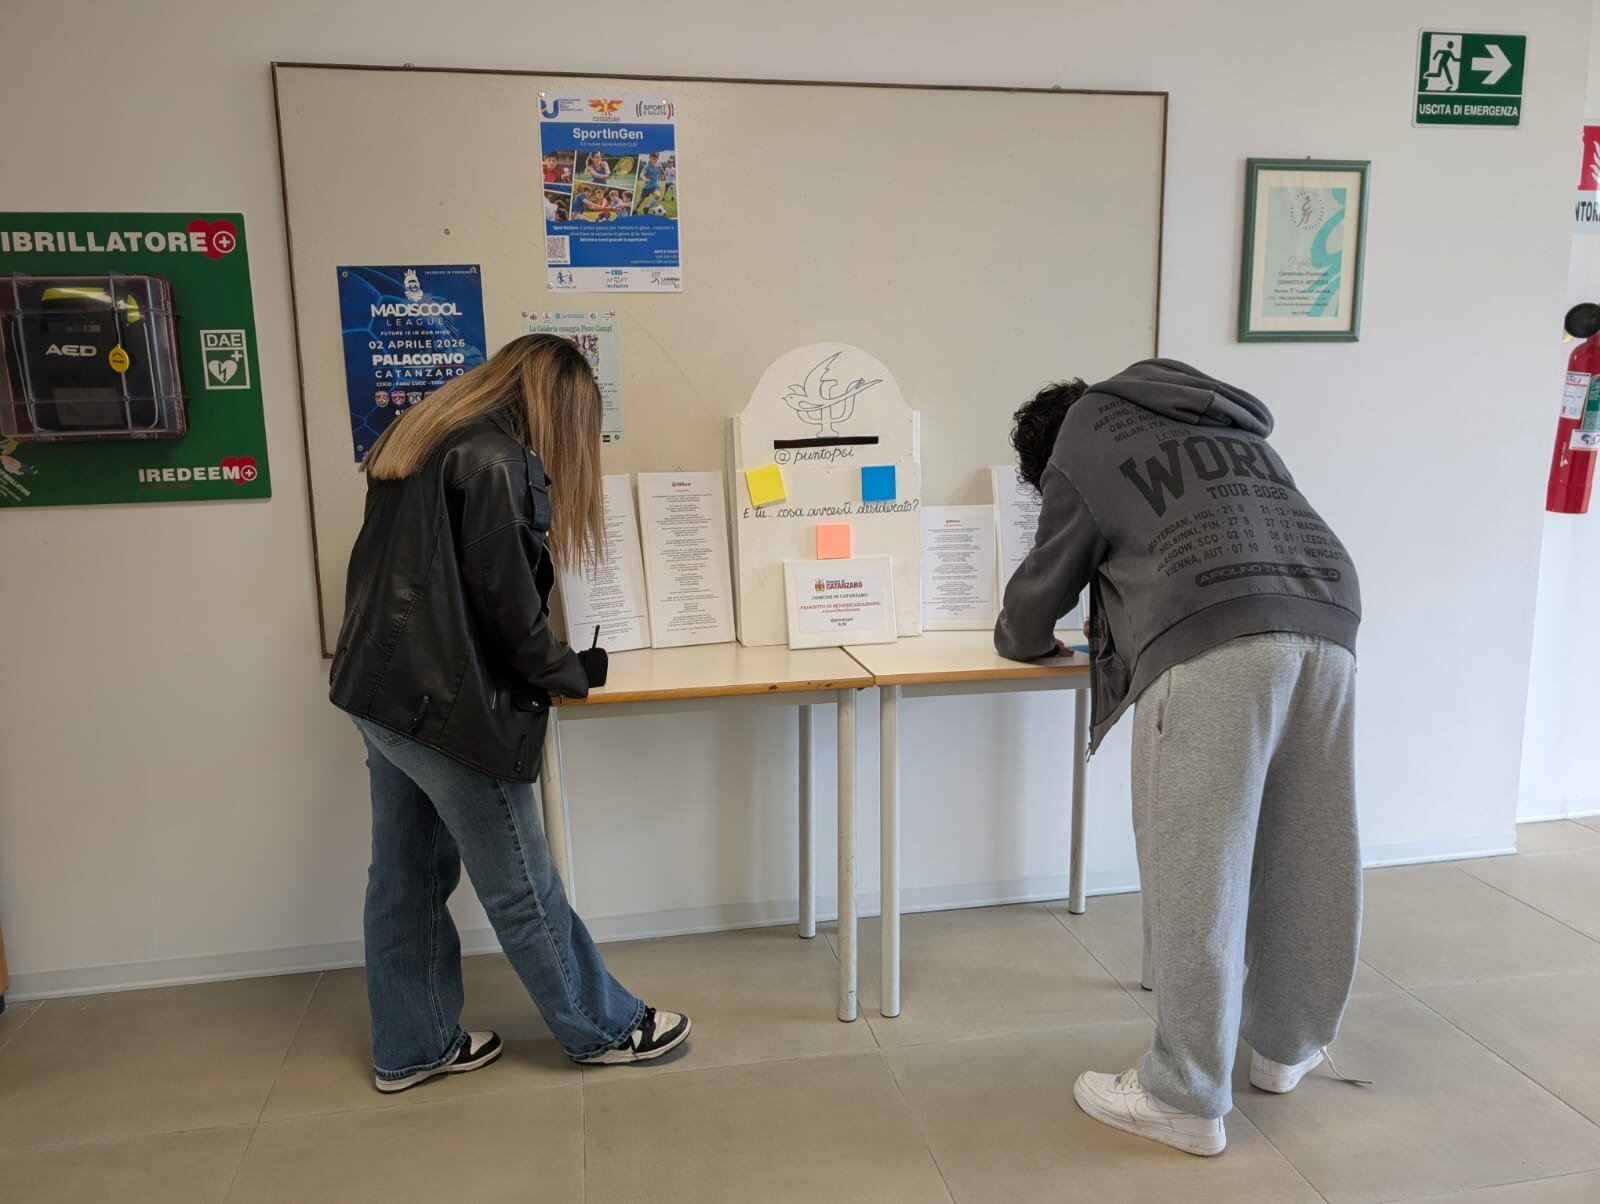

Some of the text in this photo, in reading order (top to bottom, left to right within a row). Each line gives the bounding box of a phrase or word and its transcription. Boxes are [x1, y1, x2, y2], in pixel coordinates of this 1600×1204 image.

[1419, 103, 1519, 117] USCITA DI EMERGENZA
[572, 127, 644, 141] SportInGen
[1575, 200, 1600, 222] NTOR
[370, 302, 463, 317] MADISCOOL
[386, 318, 445, 326] LEAGUE
[206, 333, 243, 348] DAE
[368, 339, 466, 350] 02 APRILE 2026
[45, 344, 97, 357] AED
[372, 352, 465, 366] PALACORVO
[375, 368, 465, 379] CATANZARO
[138, 466, 240, 483] IREDEEM
[1206, 484, 1289, 500] TOUR 2026
[743, 507, 750, 519] E
[776, 508, 804, 519] cosa
[1193, 509, 1215, 521] HOL
[1198, 533, 1219, 547] SCO
[1203, 546, 1224, 561] AUT
[826, 581, 863, 590] CATANZARO
